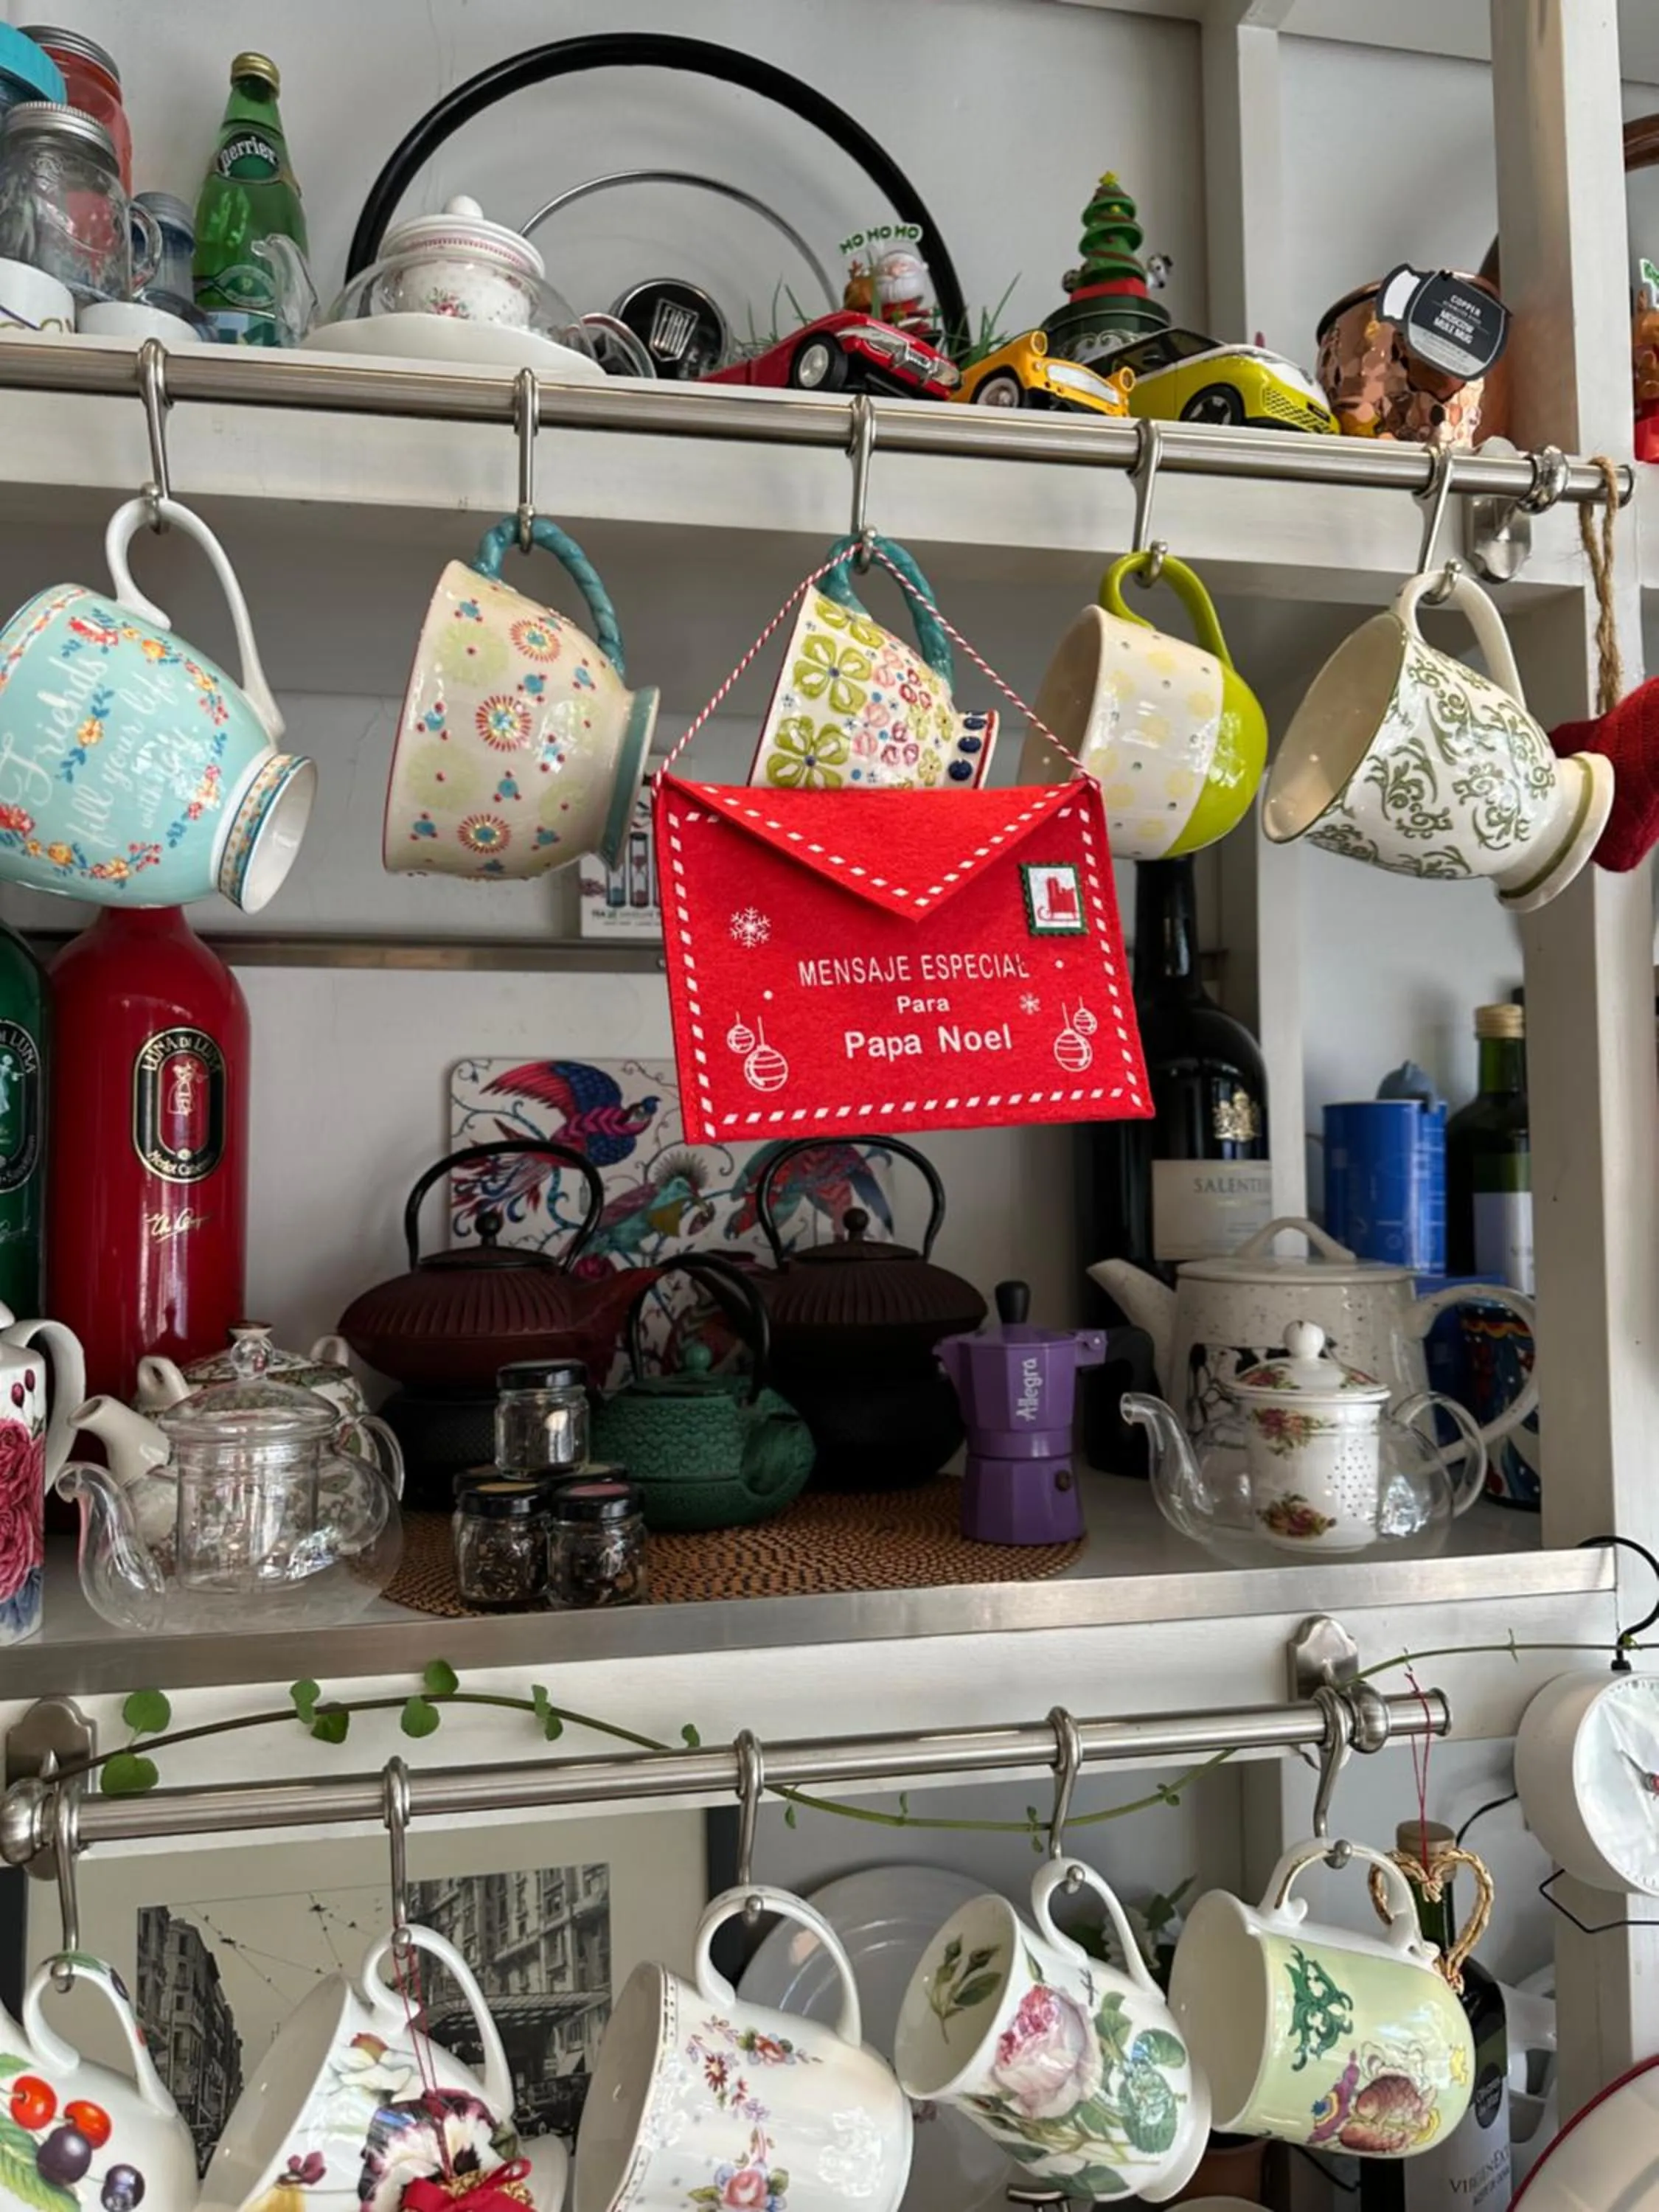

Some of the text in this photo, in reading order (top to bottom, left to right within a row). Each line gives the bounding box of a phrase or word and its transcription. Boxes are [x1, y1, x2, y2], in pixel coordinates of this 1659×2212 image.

[839, 224, 919, 254] HO HO HO
[1450, 294, 1482, 318] COPPER
[654, 305, 693, 349] FIAT
[0, 655, 108, 807] Friends
[66, 670, 178, 848] fill your life
[798, 953, 1030, 987] MENSAJE ESPECIAL
[897, 995, 950, 1015] Para
[142, 1035, 178, 1071] LUNA
[178, 1036, 190, 1048] DI
[844, 1023, 1013, 1062] Papa Noel
[1015, 1357, 1043, 1422] Allegra
